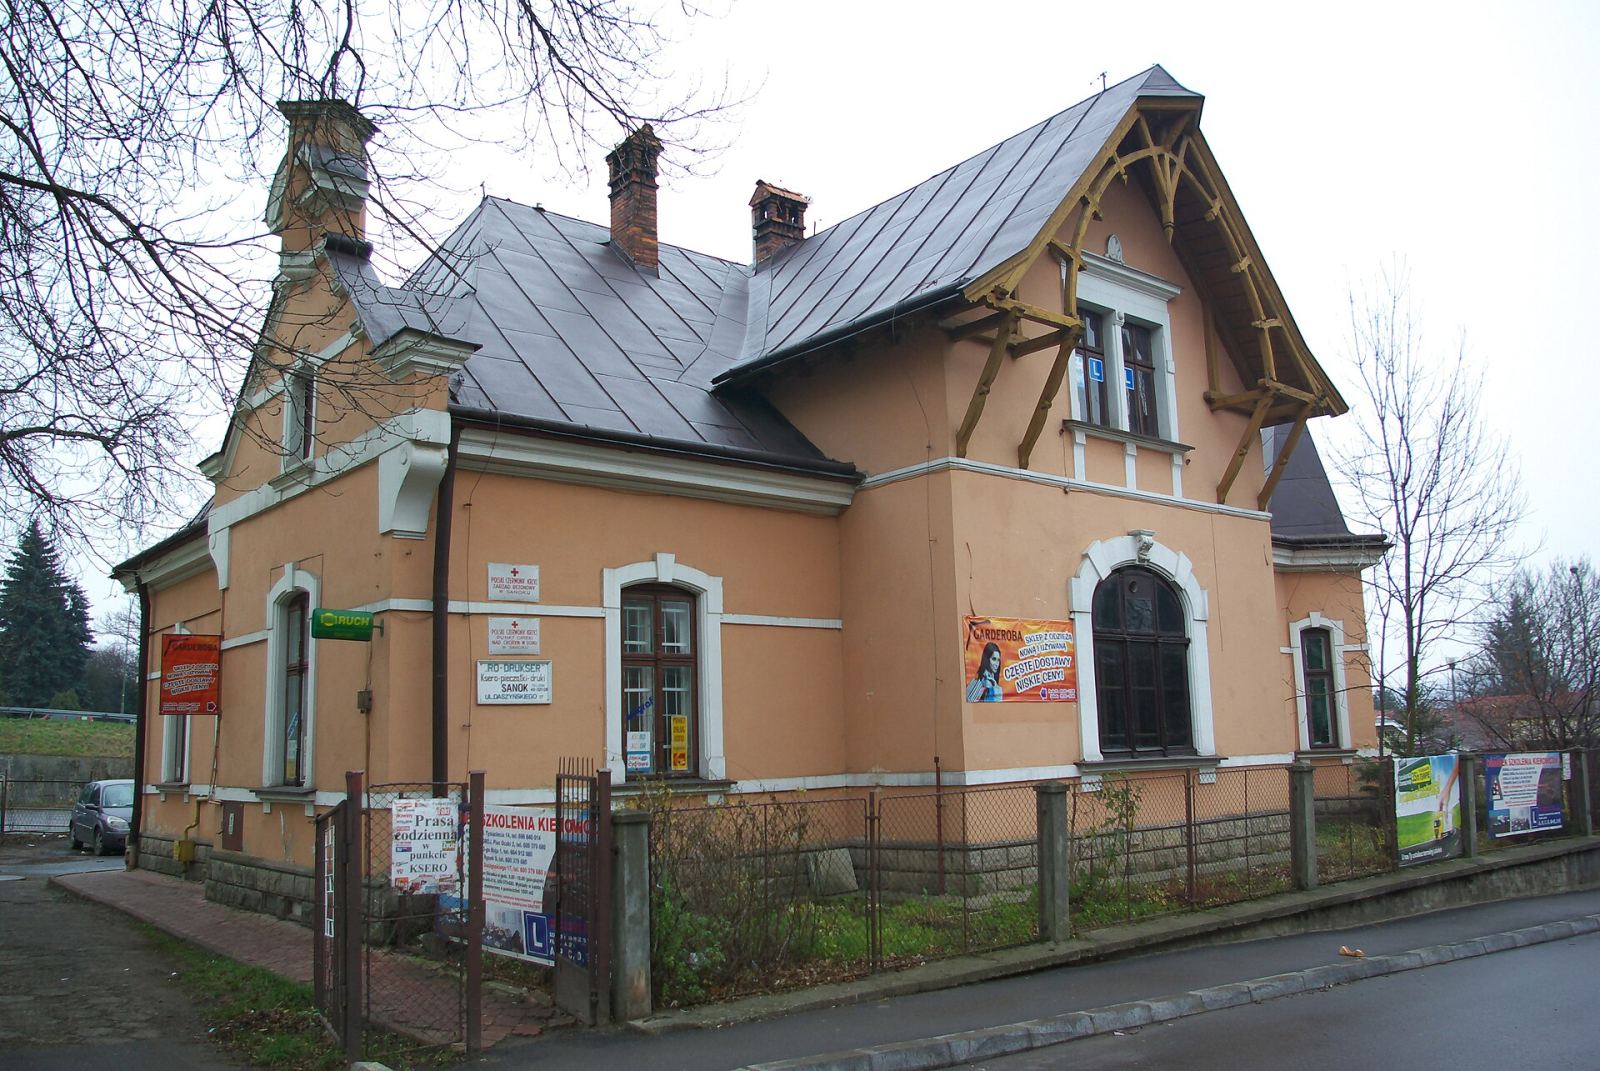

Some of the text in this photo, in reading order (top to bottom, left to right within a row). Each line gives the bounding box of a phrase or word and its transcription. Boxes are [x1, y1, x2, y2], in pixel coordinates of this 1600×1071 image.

[1093, 362, 1100, 376] L
[339, 616, 370, 626] RUCH
[974, 628, 1024, 641] GARDEROBA
[1025, 634, 1043, 643] SKLEP
[1035, 656, 1071, 668] DOSTAWY
[1016, 670, 1064, 690] NISKIE CENY!
[502, 684, 528, 692] SANOK
[416, 815, 454, 827] Prasa
[481, 814, 535, 831] SZKOLENIA
[394, 830, 457, 841] codzienna
[410, 851, 447, 861] punkcie
[410, 864, 448, 873] KSERO
[533, 922, 543, 948] L
